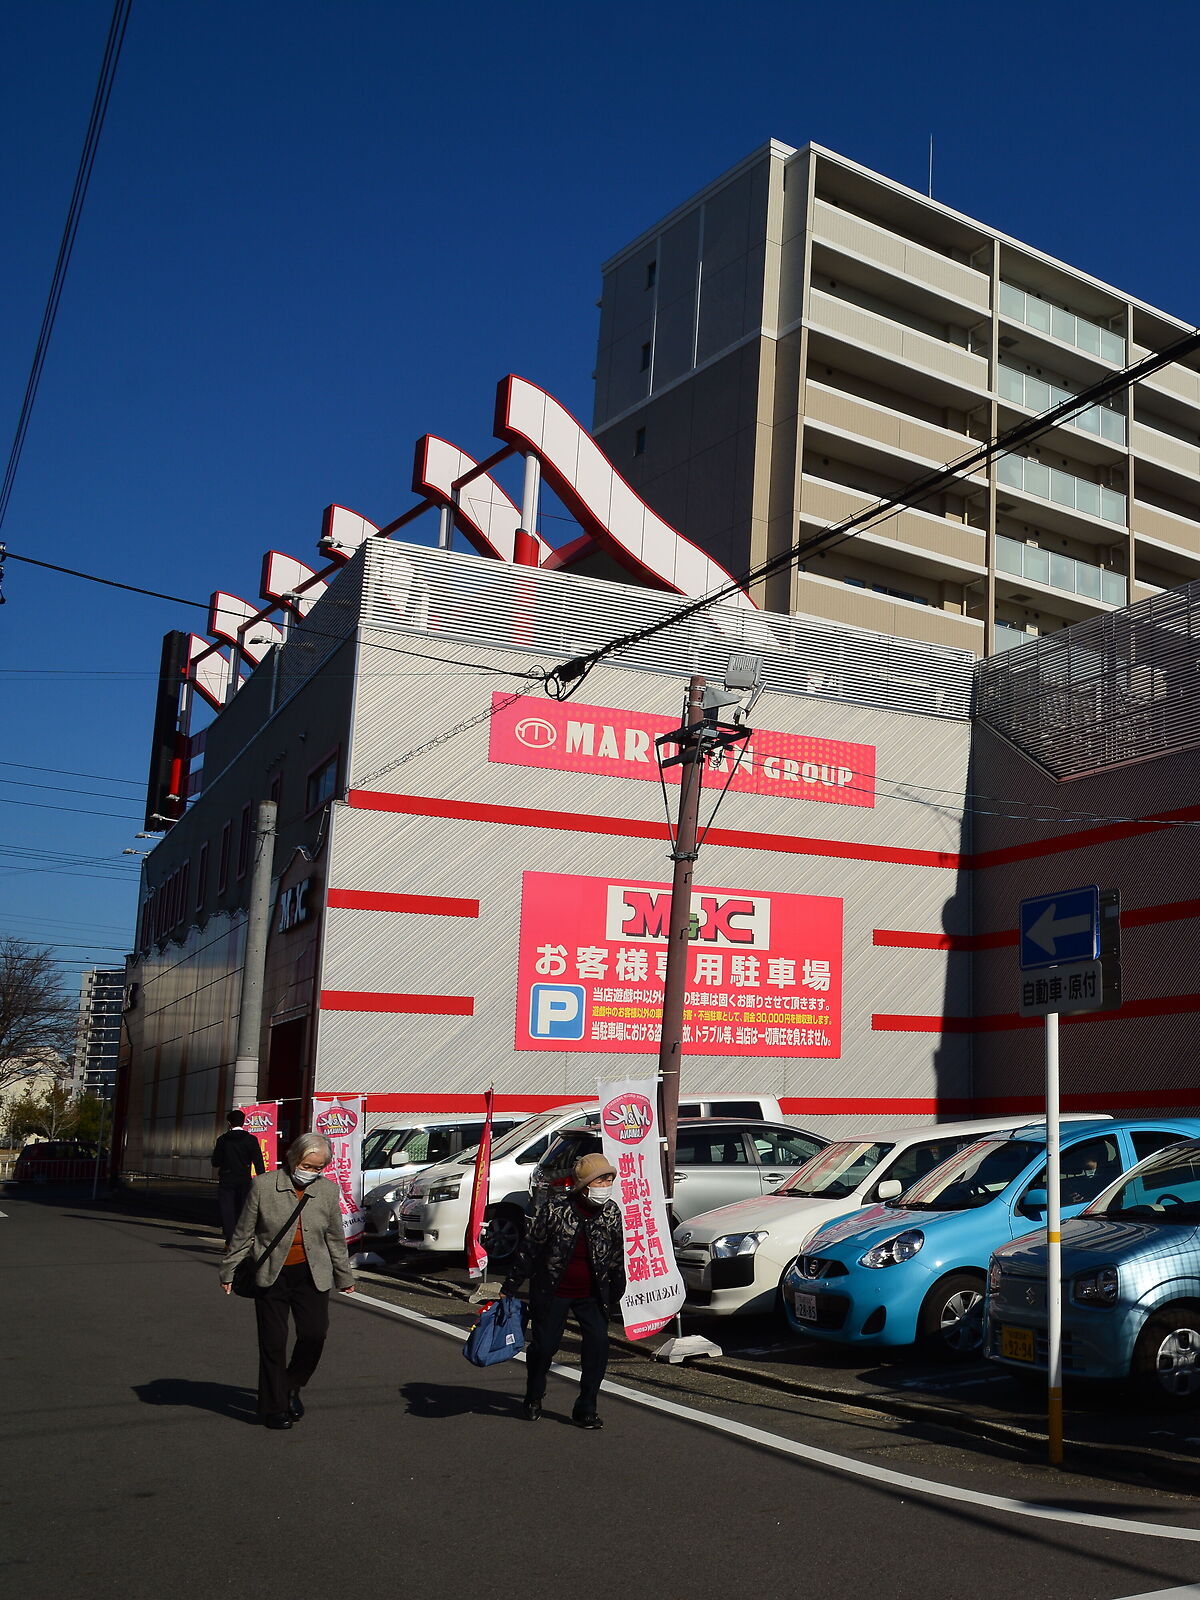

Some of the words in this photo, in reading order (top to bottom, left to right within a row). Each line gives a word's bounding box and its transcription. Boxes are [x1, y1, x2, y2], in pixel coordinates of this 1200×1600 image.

[565, 720, 754, 777] MARUAN
[764, 756, 853, 788] GROUP
[535, 943, 832, 992] お客様用駐車場
[537, 989, 579, 1035] P
[592, 986, 831, 1012] 当店遊戯中以外の駐車は固くお断りさせて頂きます。
